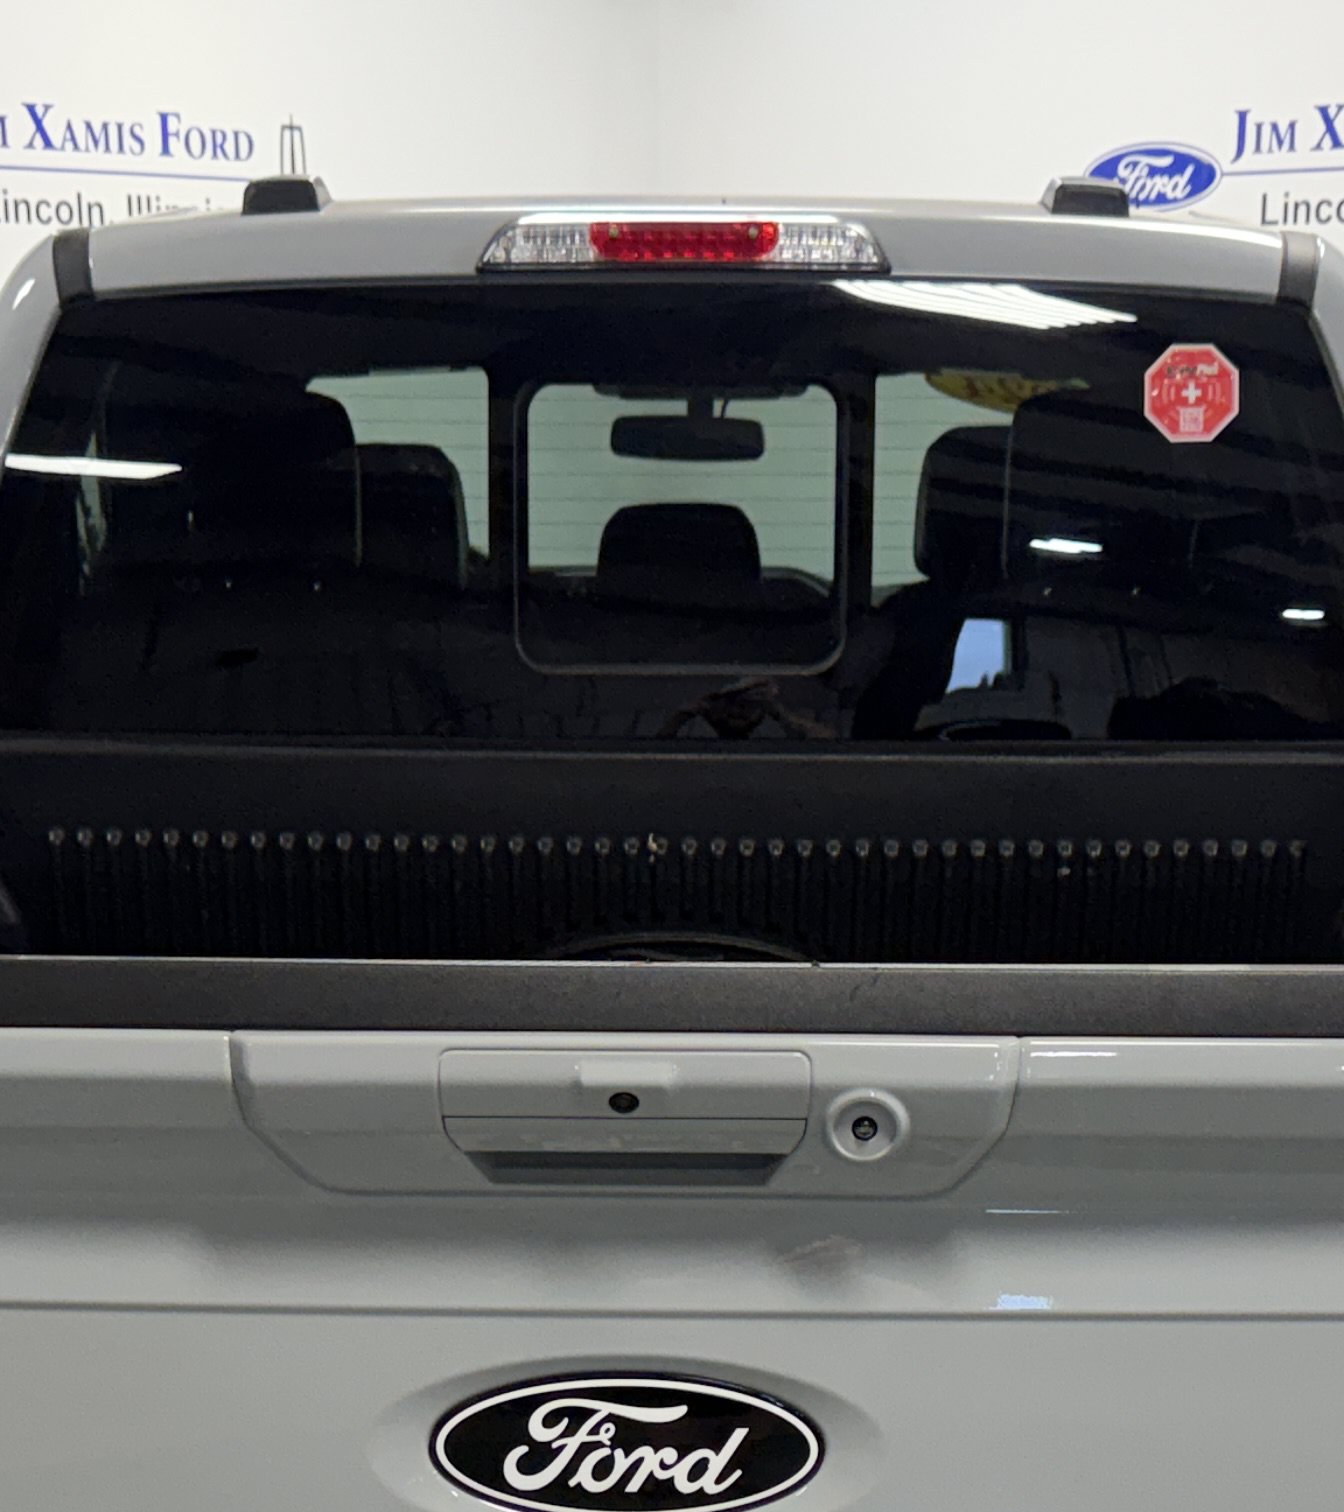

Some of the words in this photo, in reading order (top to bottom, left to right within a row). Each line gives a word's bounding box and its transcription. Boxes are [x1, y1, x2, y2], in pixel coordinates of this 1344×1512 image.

[21, 102, 145, 156] XAMIS
[157, 111, 254, 162] FORD
[1230, 109, 1298, 164] JIM
[1113, 154, 1195, 202] Ford
[503, 1398, 749, 1495] Ford
